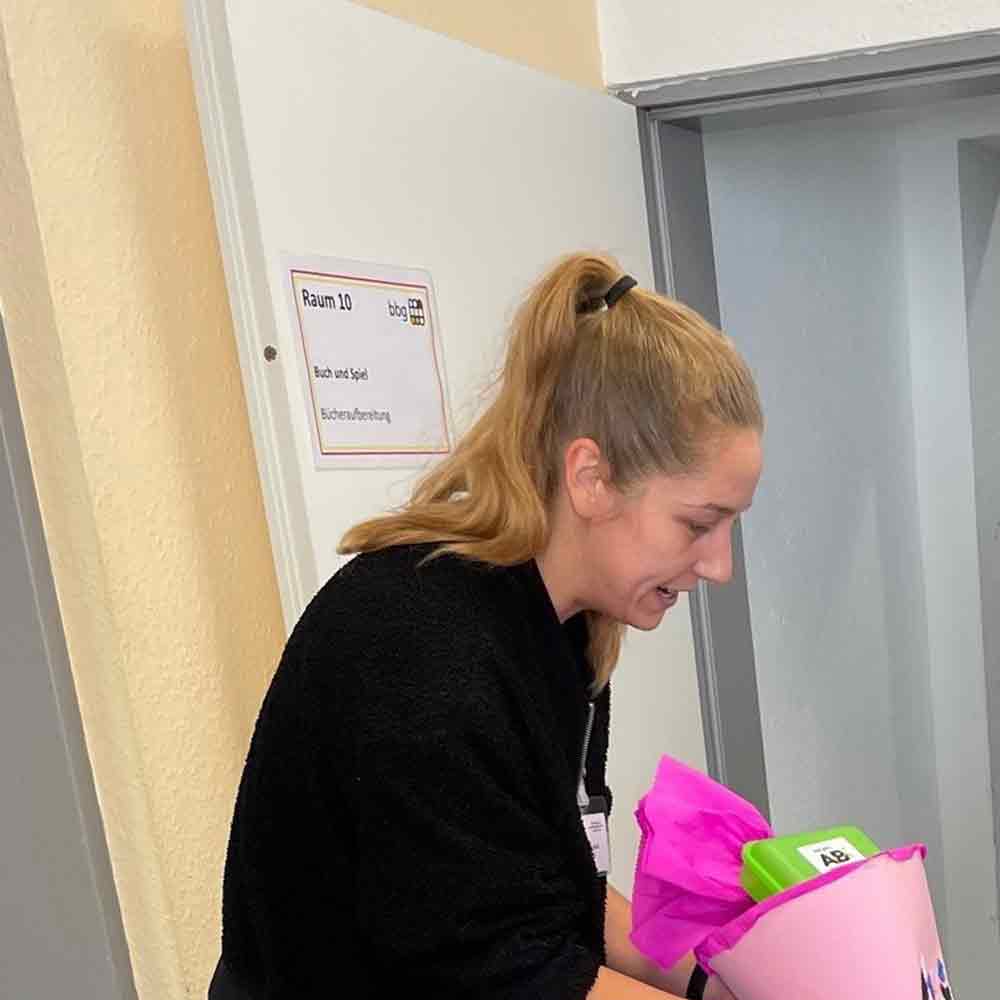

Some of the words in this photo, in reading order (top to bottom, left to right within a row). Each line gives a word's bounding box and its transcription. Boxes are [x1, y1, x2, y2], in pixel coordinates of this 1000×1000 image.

[302, 288, 335, 309] Raum
[338, 293, 352, 311] 10
[387, 300, 408, 321] bbg
[313, 365, 333, 379] Buch
[335, 367, 349, 379] und
[350, 368, 368, 381] Spiel
